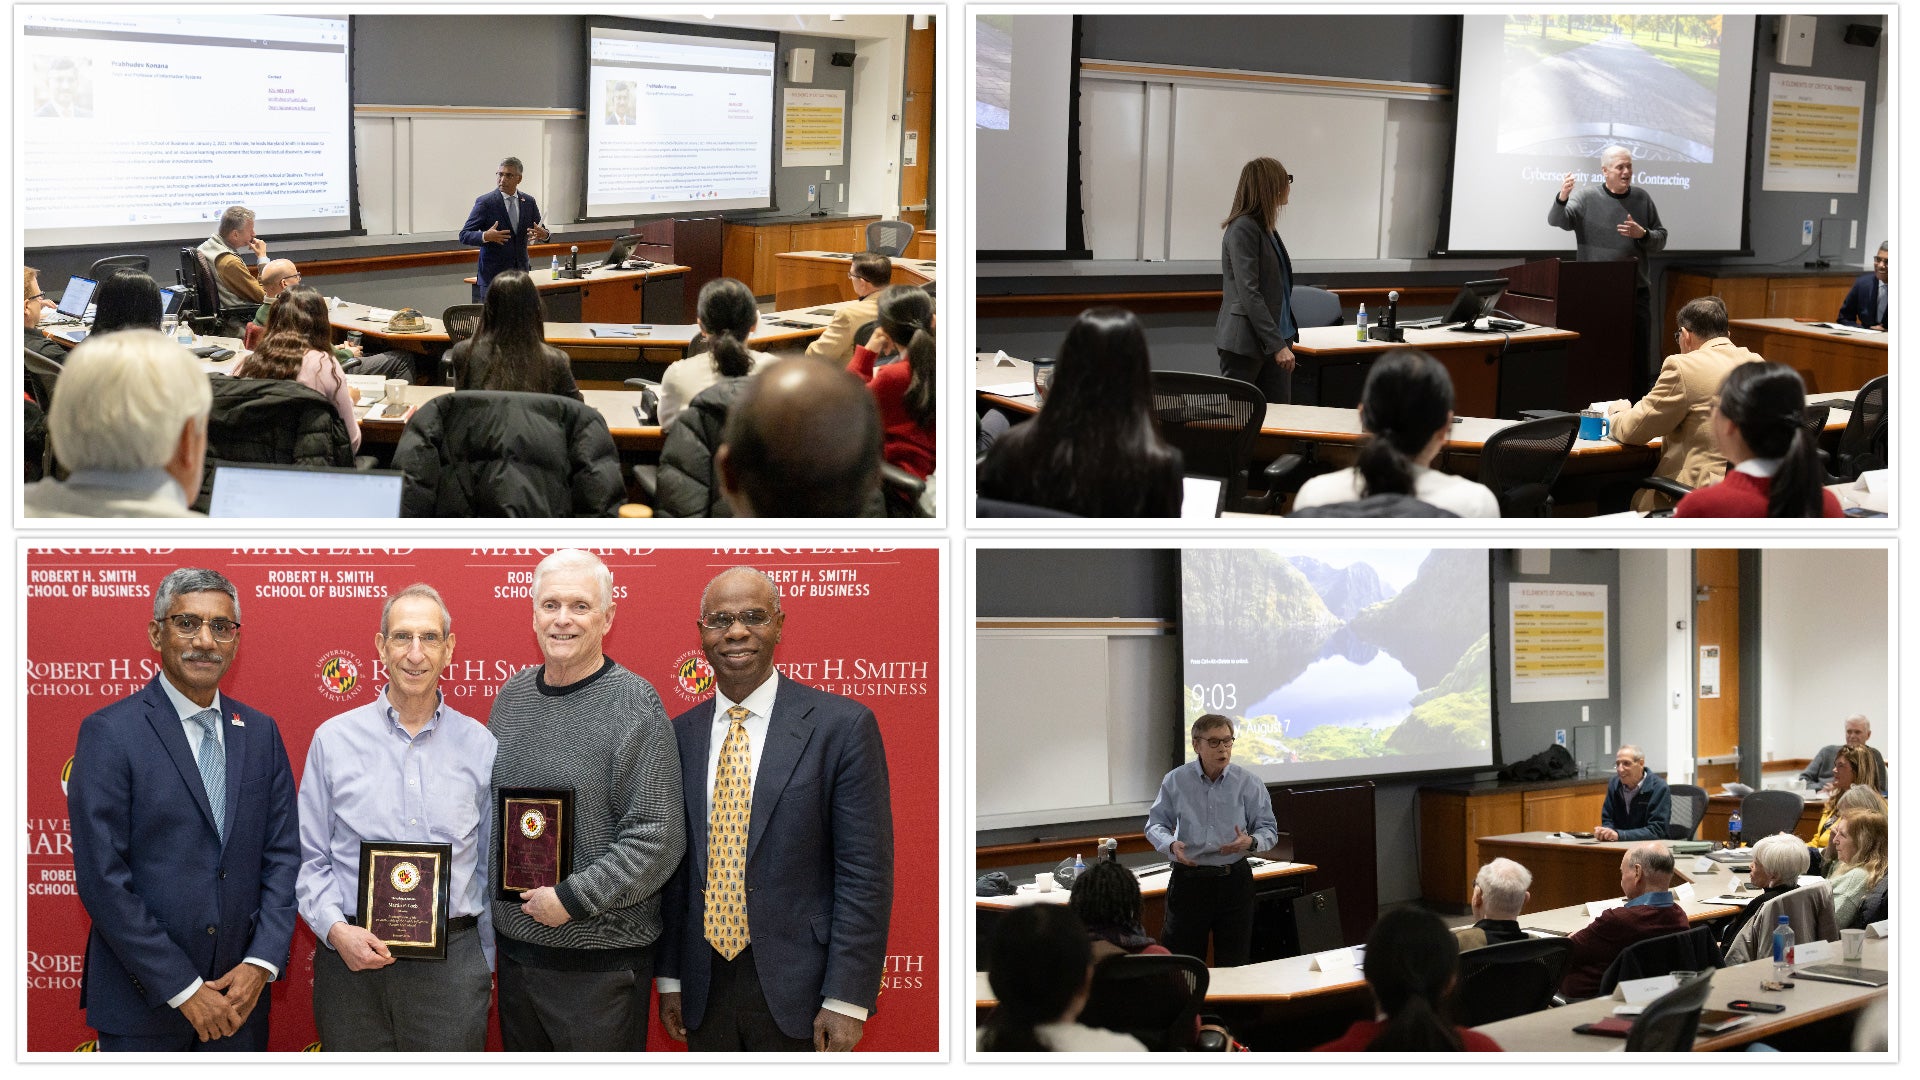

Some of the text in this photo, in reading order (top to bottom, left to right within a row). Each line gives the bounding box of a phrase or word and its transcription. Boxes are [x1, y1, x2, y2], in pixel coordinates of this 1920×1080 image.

[1638, 171, 1690, 190] Contracting
[31, 570, 136, 582] ROBERT H. SMITH
[268, 570, 374, 583] ROBERT H. SMITH
[802, 570, 814, 582] H.
[818, 569, 857, 582] SMITH
[27, 584, 150, 597] CHOOL OF BUSINESS
[255, 585, 388, 598] SCHOOL OF BUSINESS
[790, 584, 870, 597] OF BUSINESS
[316, 650, 355, 668] UNIVERSITY
[110, 658, 137, 680] H.
[464, 660, 492, 681] H.
[823, 659, 850, 680] H.
[854, 658, 928, 679] SMITH
[27, 683, 123, 696] CHOOL OF
[318, 684, 362, 702] MARYLAND
[454, 686, 477, 697] OF
[842, 683, 928, 696] BUSINESS
[1191, 683, 1237, 710] 9:03
[1246, 722, 1282, 737] August
[1284, 720, 1290, 732] 7
[28, 884, 78, 895] SCHOOL
